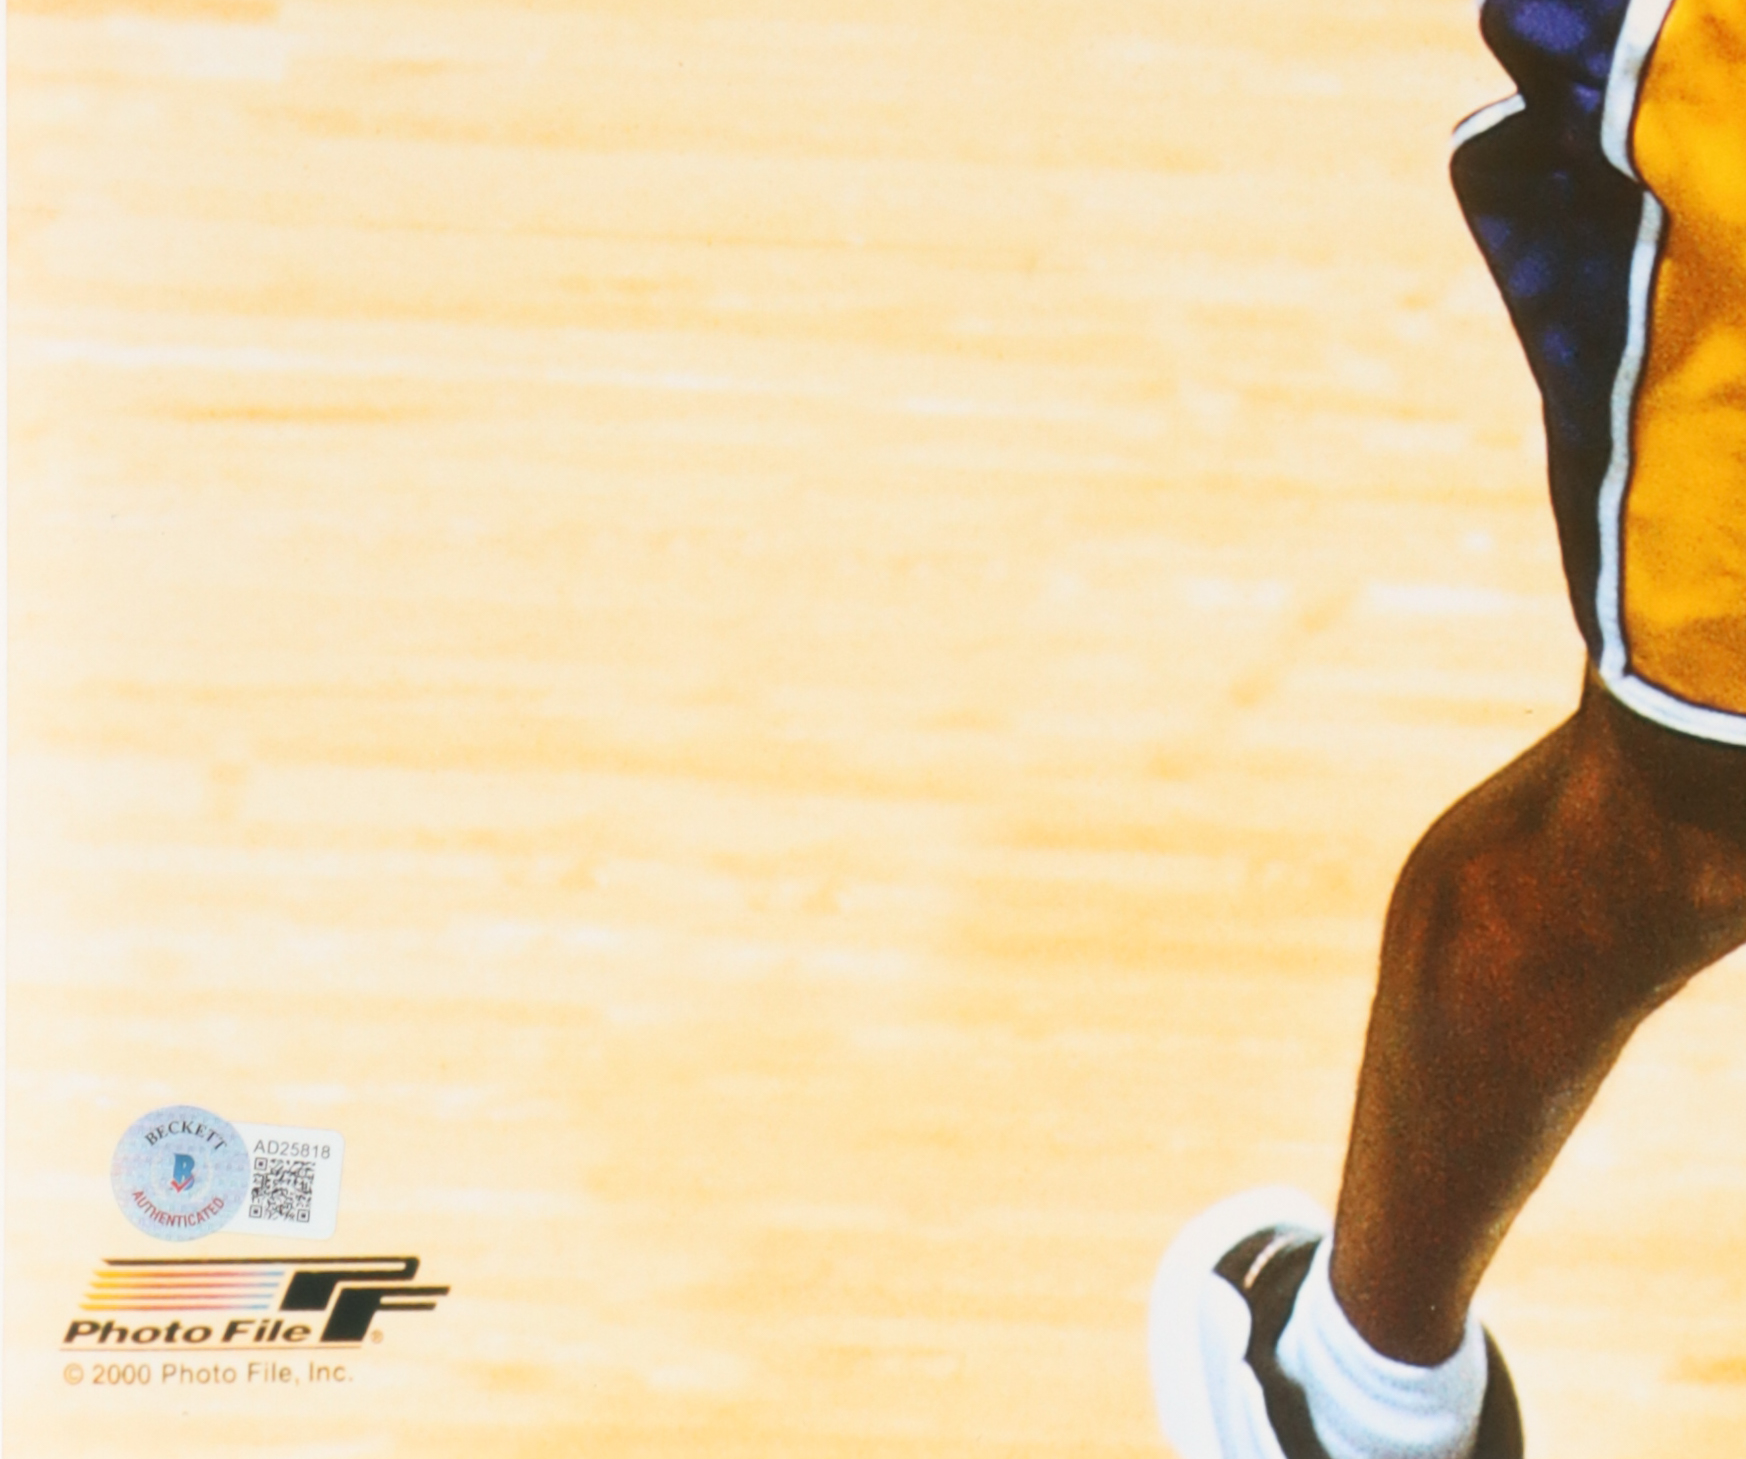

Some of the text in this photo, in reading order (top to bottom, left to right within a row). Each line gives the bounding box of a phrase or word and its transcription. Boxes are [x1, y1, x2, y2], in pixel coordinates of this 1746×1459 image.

[144, 1119, 228, 1152] BECKETT
[253, 1139, 332, 1160] AD25818
[132, 1189, 225, 1228] AUTHENTICATED
